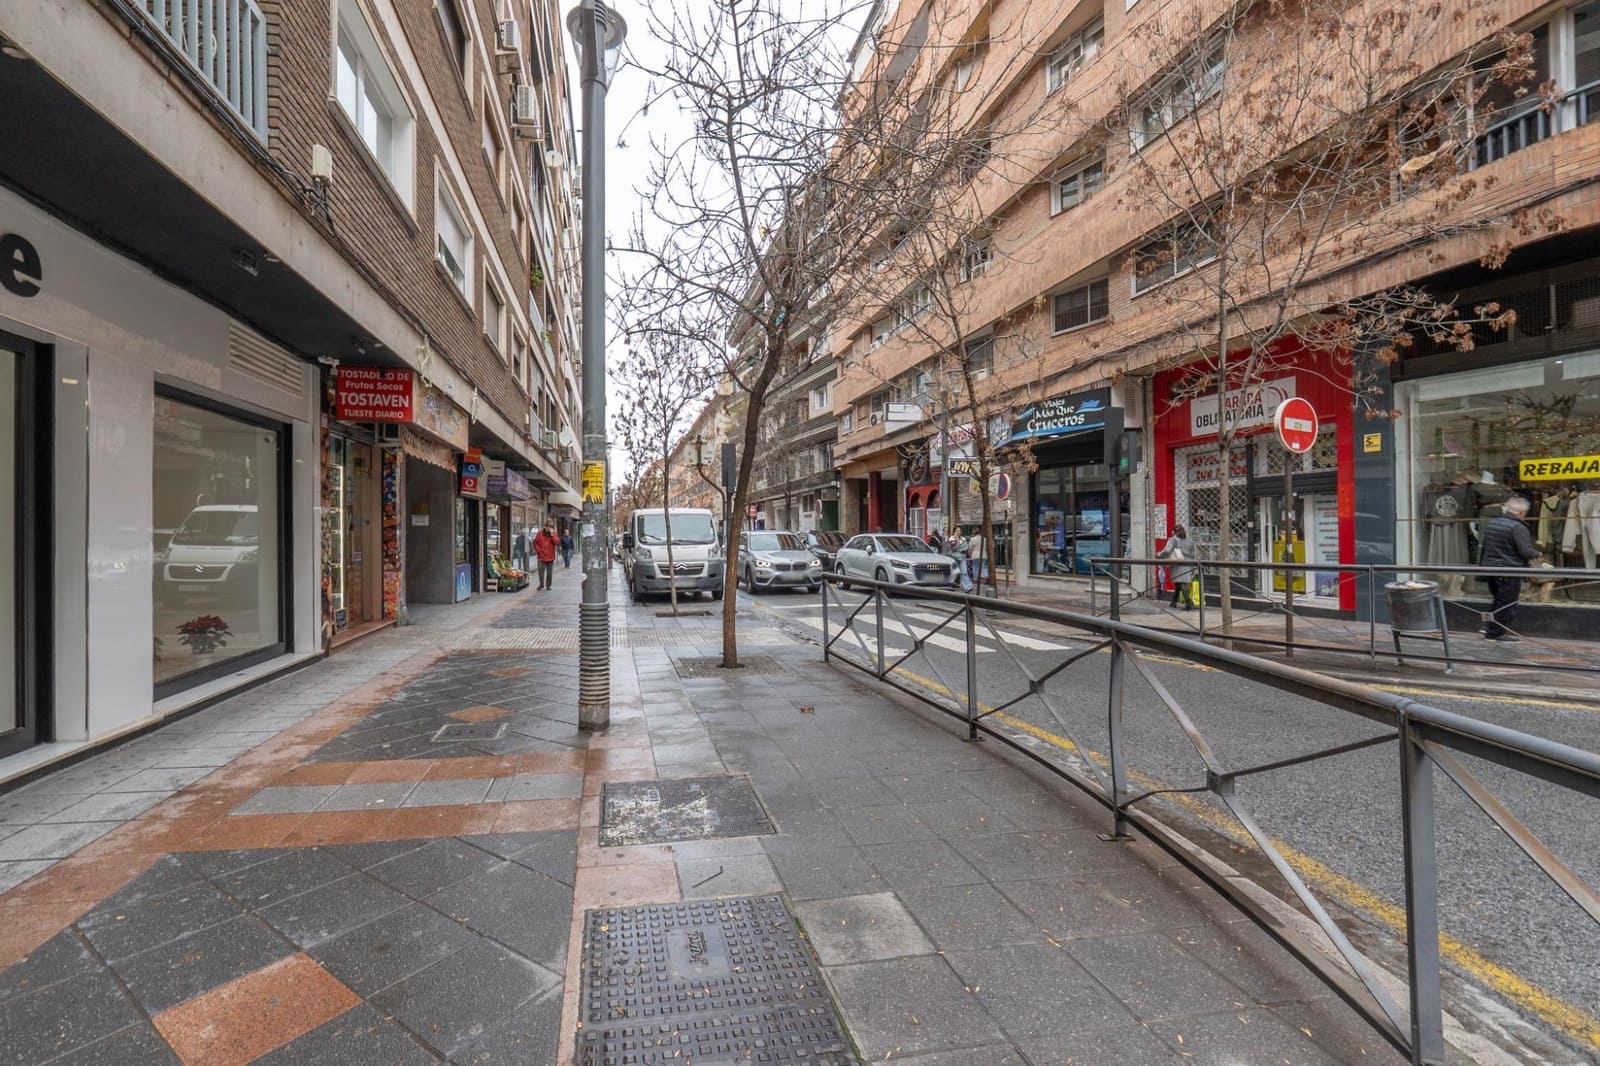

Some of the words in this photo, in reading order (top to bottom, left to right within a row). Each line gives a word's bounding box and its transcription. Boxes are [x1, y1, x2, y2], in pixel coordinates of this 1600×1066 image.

[339, 370, 394, 380] TOSTADEO
[345, 380, 374, 389] Frutos
[376, 382, 403, 391] Secos
[339, 391, 409, 408] TOSTAVEN
[1222, 391, 1262, 409] ARDA
[344, 409, 373, 417] TUESTE
[375, 410, 404, 419] DIARIO
[1056, 405, 1075, 416] Que
[1196, 404, 1264, 428] OBLIATRIA
[1027, 414, 1085, 433] Cruceros
